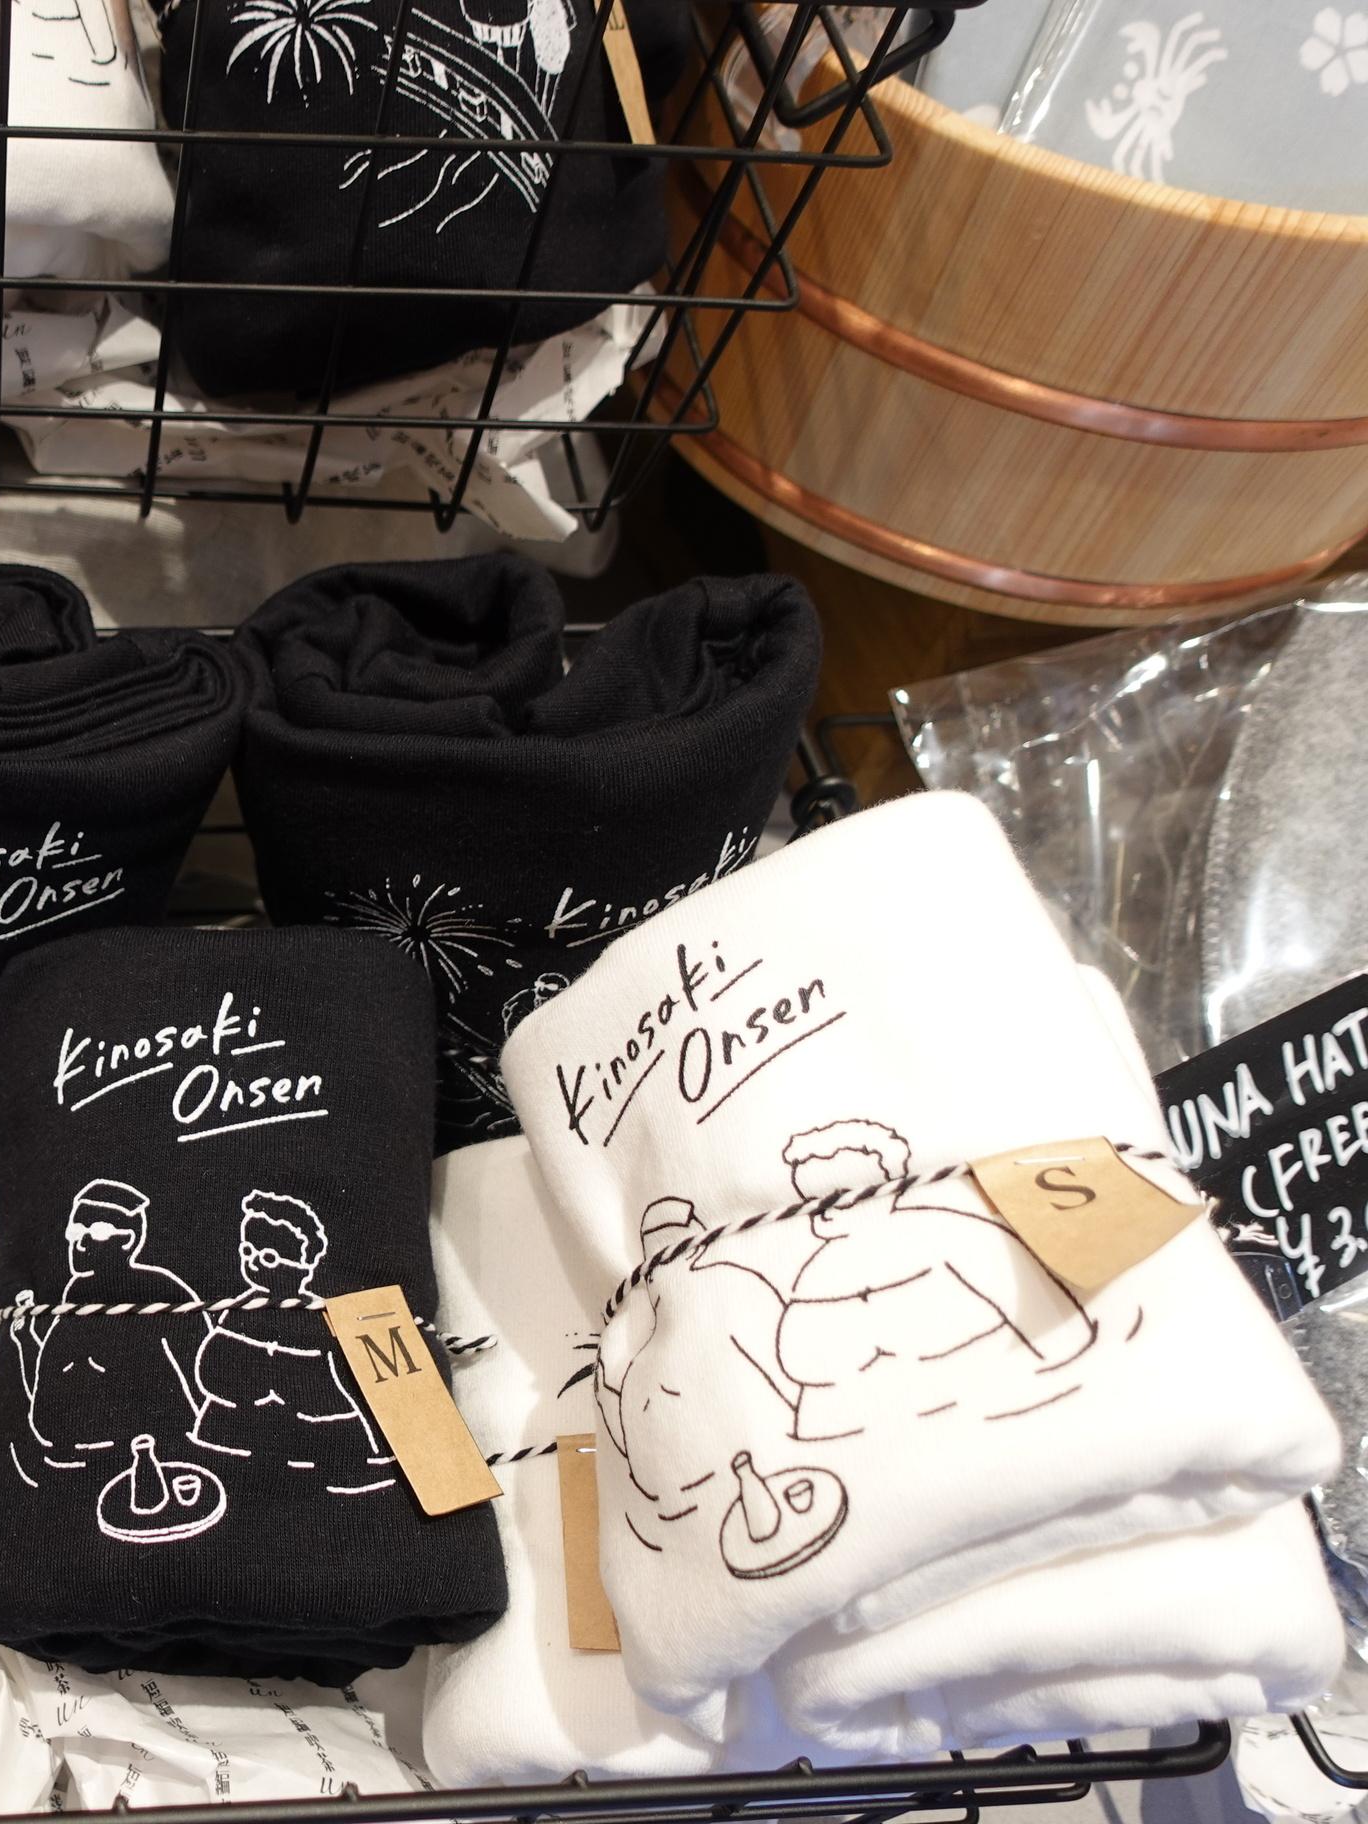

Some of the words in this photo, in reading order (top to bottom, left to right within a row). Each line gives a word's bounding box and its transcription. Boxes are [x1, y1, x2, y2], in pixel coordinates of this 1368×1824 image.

[543, 826, 750, 939] Kinosaki
[53, 992, 263, 1104] Kinosaki
[556, 940, 726, 1145] Kinosaki
[678, 977, 828, 1103] Onsen
[1282, 1007, 1368, 1106] HAT
[172, 1064, 322, 1125] Onsen
[1034, 1165, 1097, 1211] S
[355, 1326, 422, 1384] M
